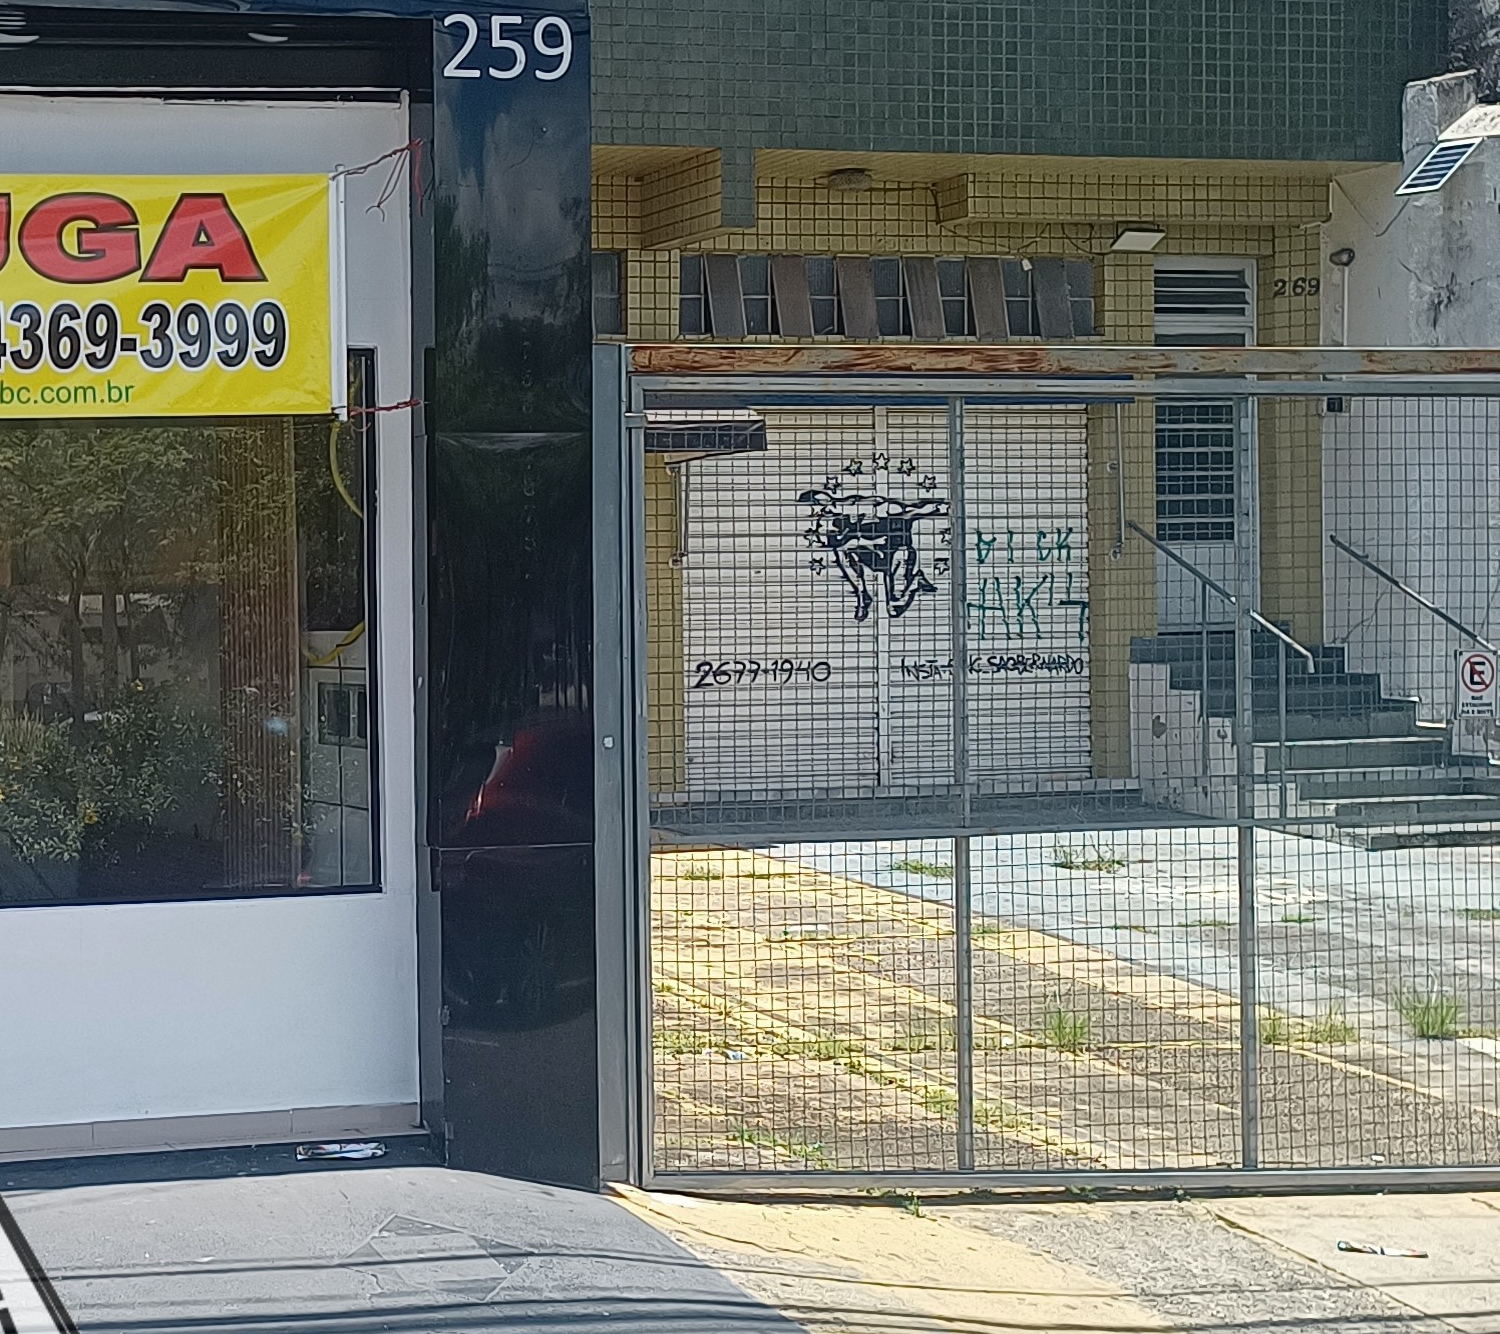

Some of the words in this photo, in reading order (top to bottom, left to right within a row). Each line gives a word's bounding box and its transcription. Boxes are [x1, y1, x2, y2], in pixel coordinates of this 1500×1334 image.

[442, 13, 572, 80] 259
[1272, 276, 1320, 299] 269
[692, 658, 831, 688] 2677-1940
